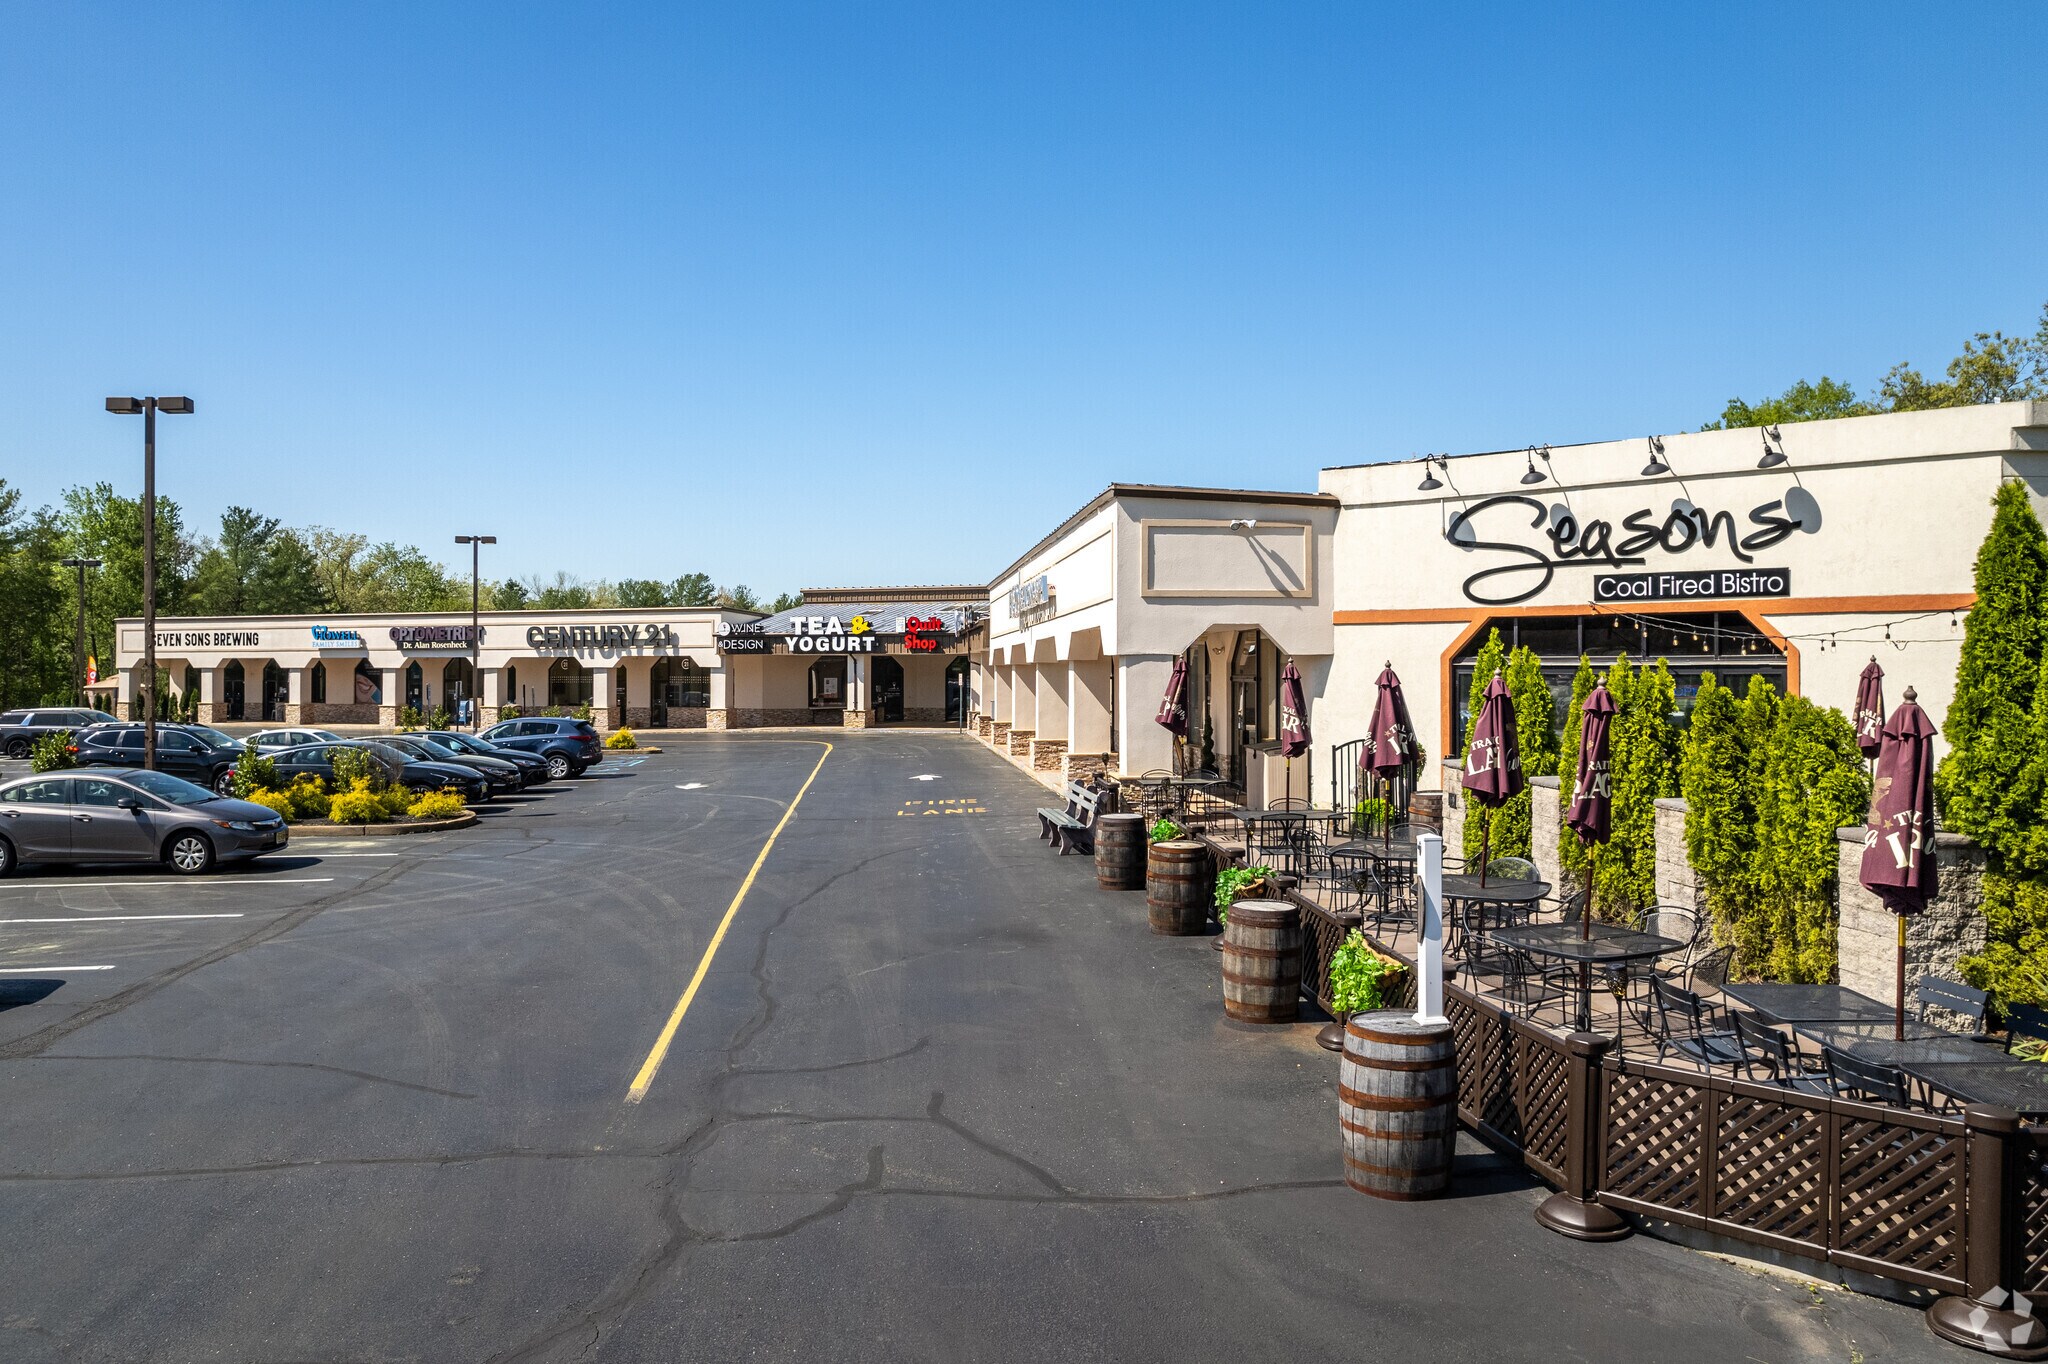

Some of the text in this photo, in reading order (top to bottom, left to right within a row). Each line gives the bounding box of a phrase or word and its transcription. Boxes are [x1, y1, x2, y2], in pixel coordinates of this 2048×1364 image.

[1446, 494, 1802, 604] Seasons
[1597, 571, 1784, 598] Coal Fired Bistro
[731, 623, 761, 634] WINE
[789, 615, 871, 636] TEA &
[906, 616, 943, 635] Quilt
[184, 633, 211, 647] SONS
[213, 632, 260, 647] BREWING
[315, 630, 358, 641] HOWELL
[526, 624, 672, 649] CENTURY 21
[784, 636, 875, 652] YOGURT
[904, 634, 937, 652] Shop
[402, 641, 468, 649] Dr. Alan Rosenheck
[897, 807, 988, 816] LANE
